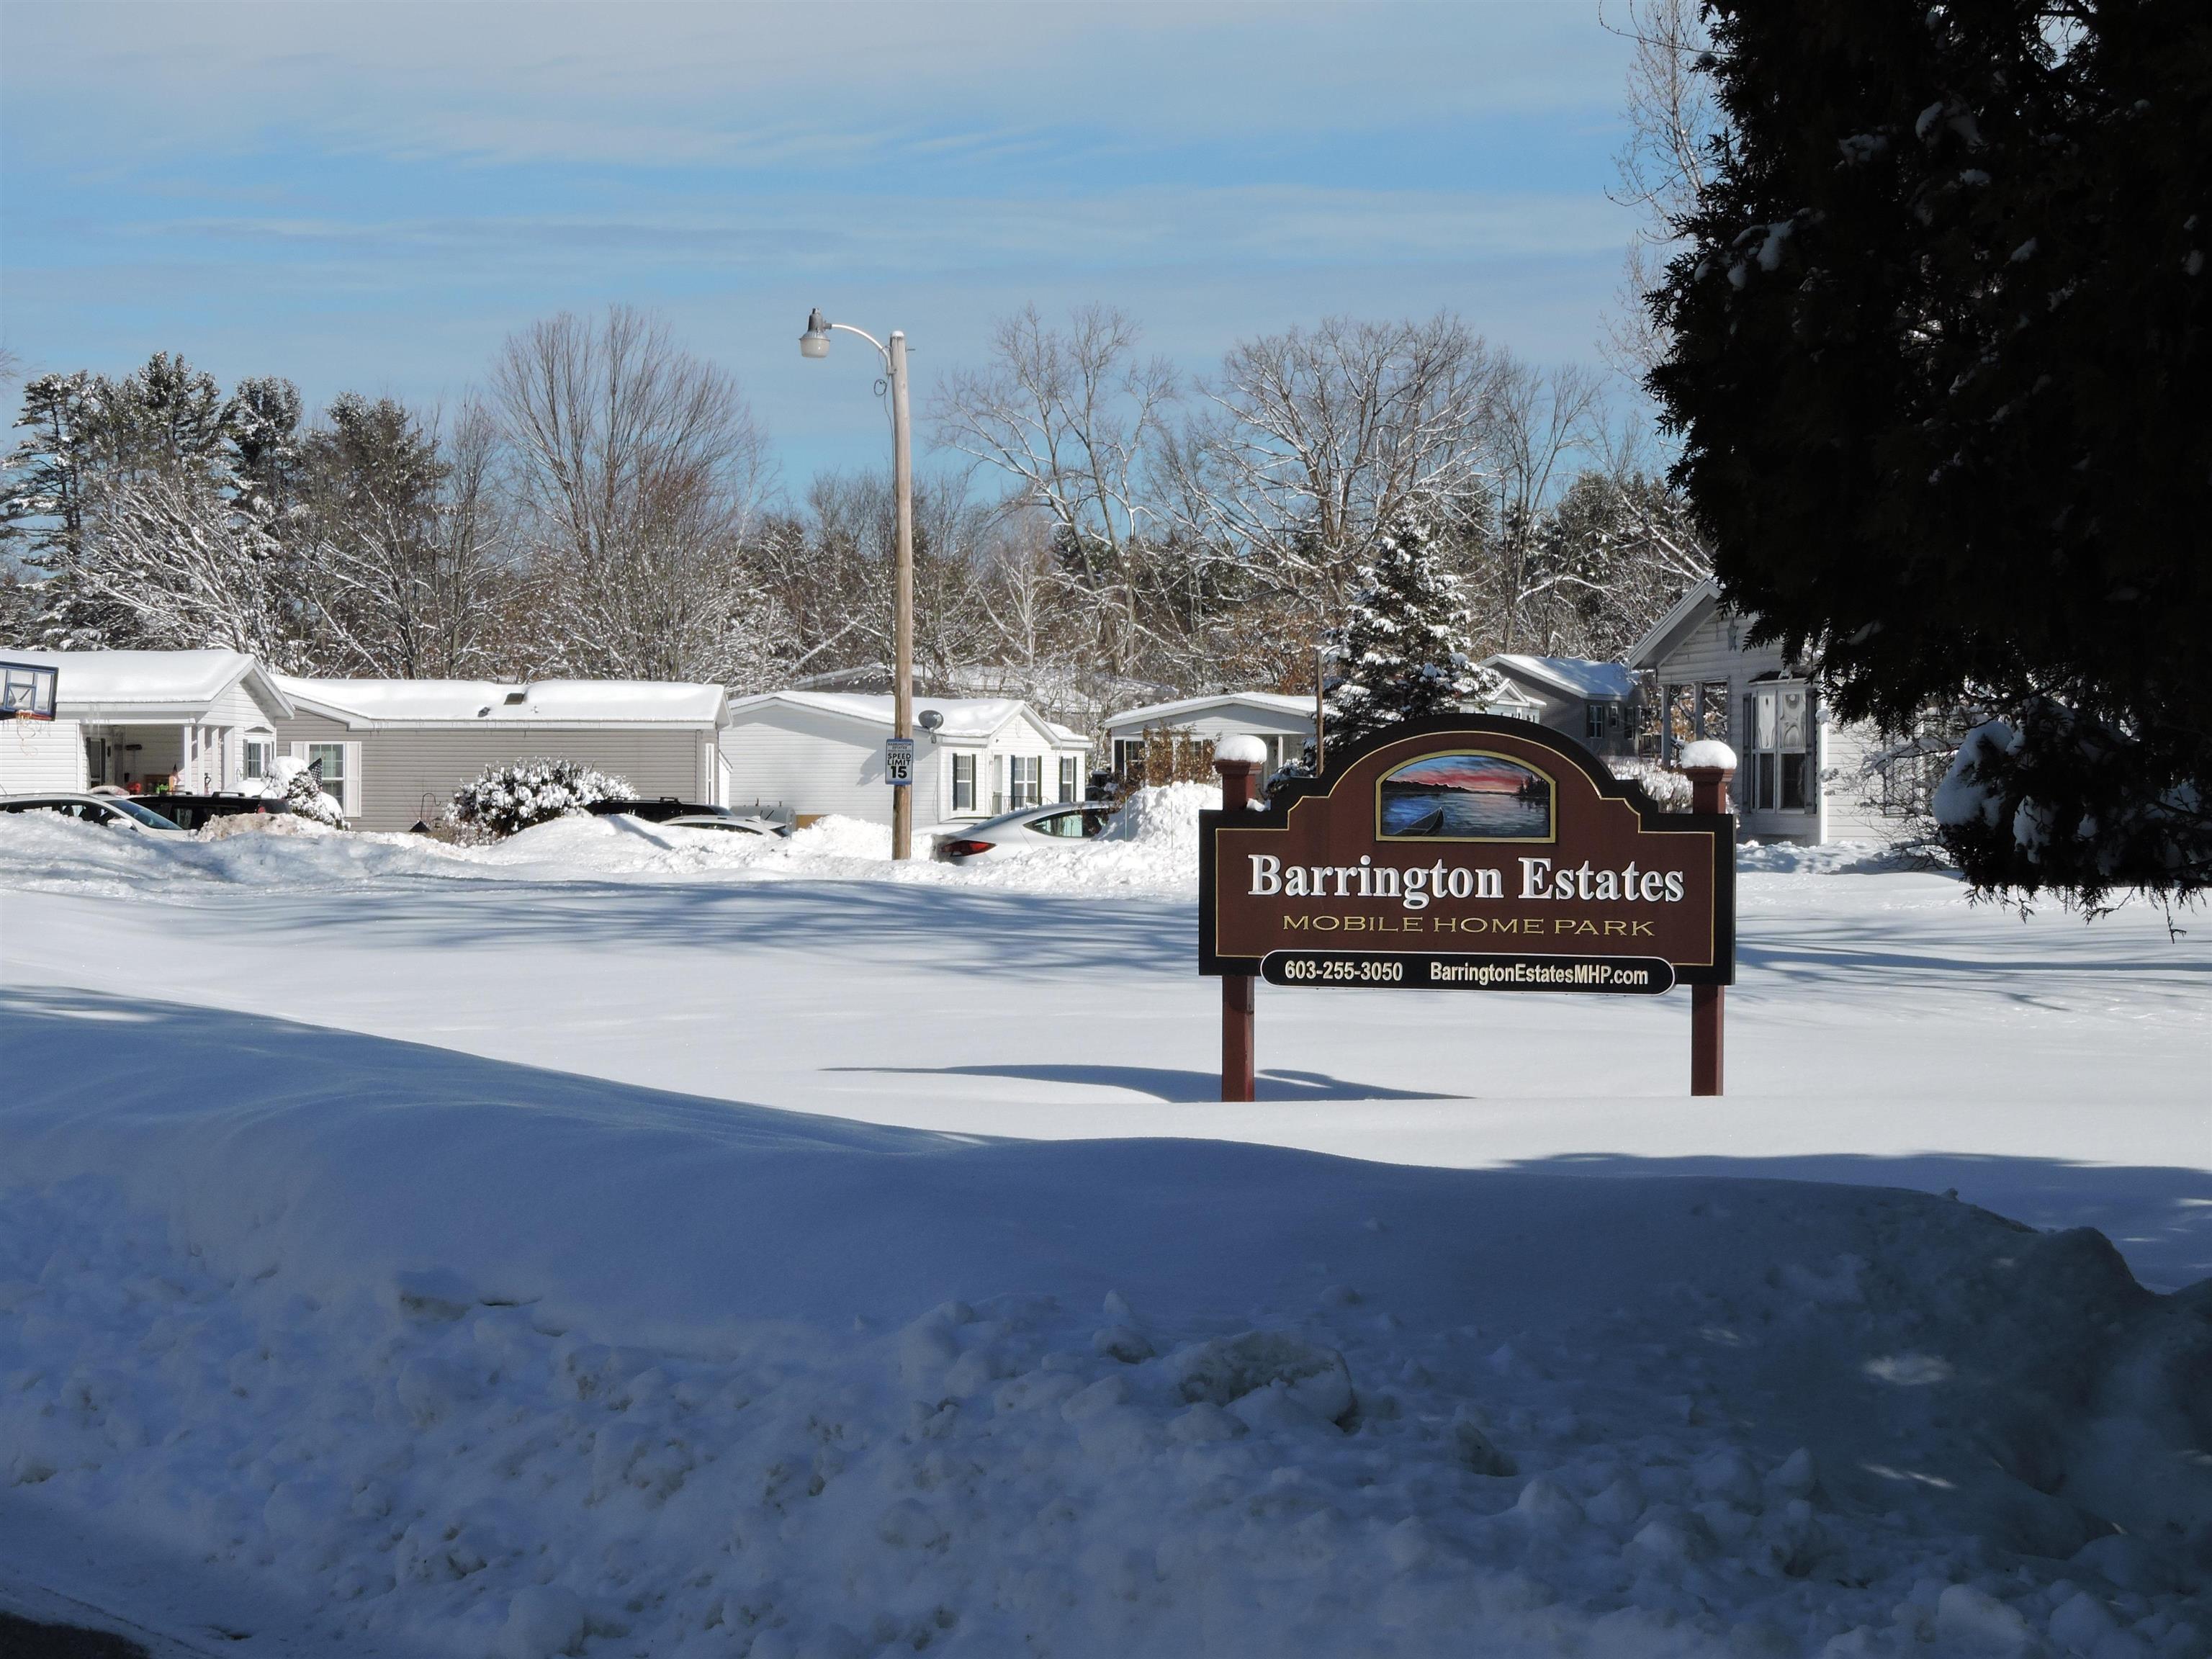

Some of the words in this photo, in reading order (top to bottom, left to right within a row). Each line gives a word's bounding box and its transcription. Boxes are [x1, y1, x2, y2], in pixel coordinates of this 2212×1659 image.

[891, 766, 907, 778] 15
[1247, 854, 1504, 909] Barrington
[1518, 858, 1685, 903] Estates
[1282, 915, 1424, 932] MOBILE
[1432, 917, 1545, 935] HOME
[1554, 920, 1655, 937] PARK
[1285, 960, 1403, 981] 603-255-3050
[1430, 961, 1649, 986] BarringtonEstatesMHP.com
